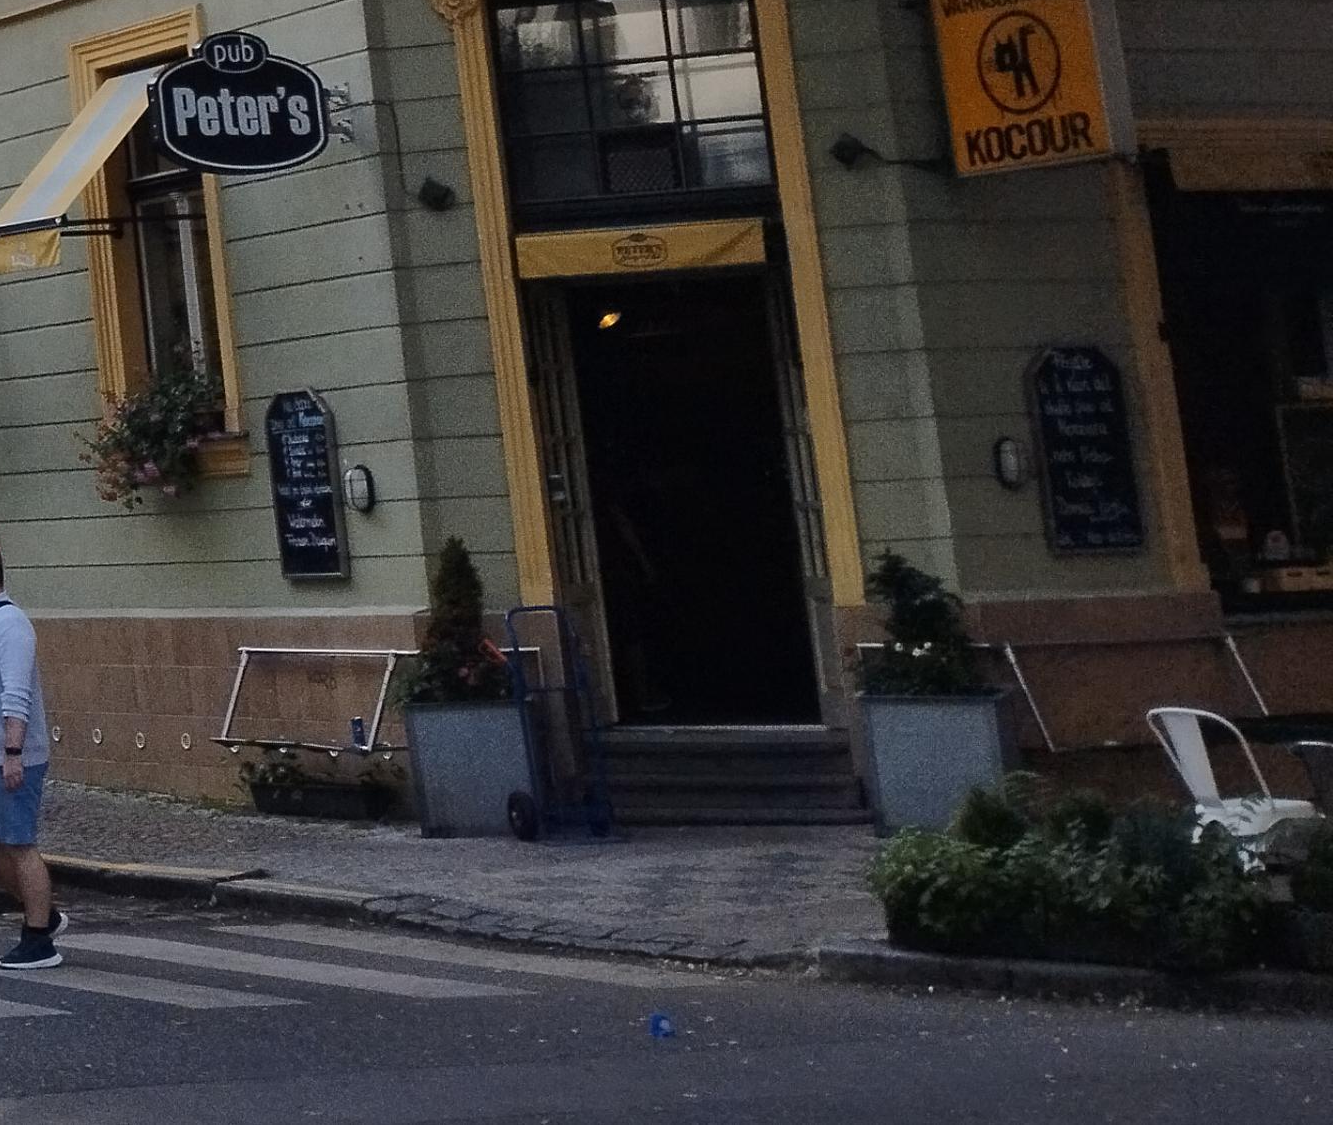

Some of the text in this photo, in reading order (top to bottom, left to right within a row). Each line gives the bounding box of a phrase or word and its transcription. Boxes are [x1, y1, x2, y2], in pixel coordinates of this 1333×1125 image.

[213, 35, 254, 69] pub
[172, 86, 311, 137] Peter's
[965, 112, 1094, 167] KOCOUR
